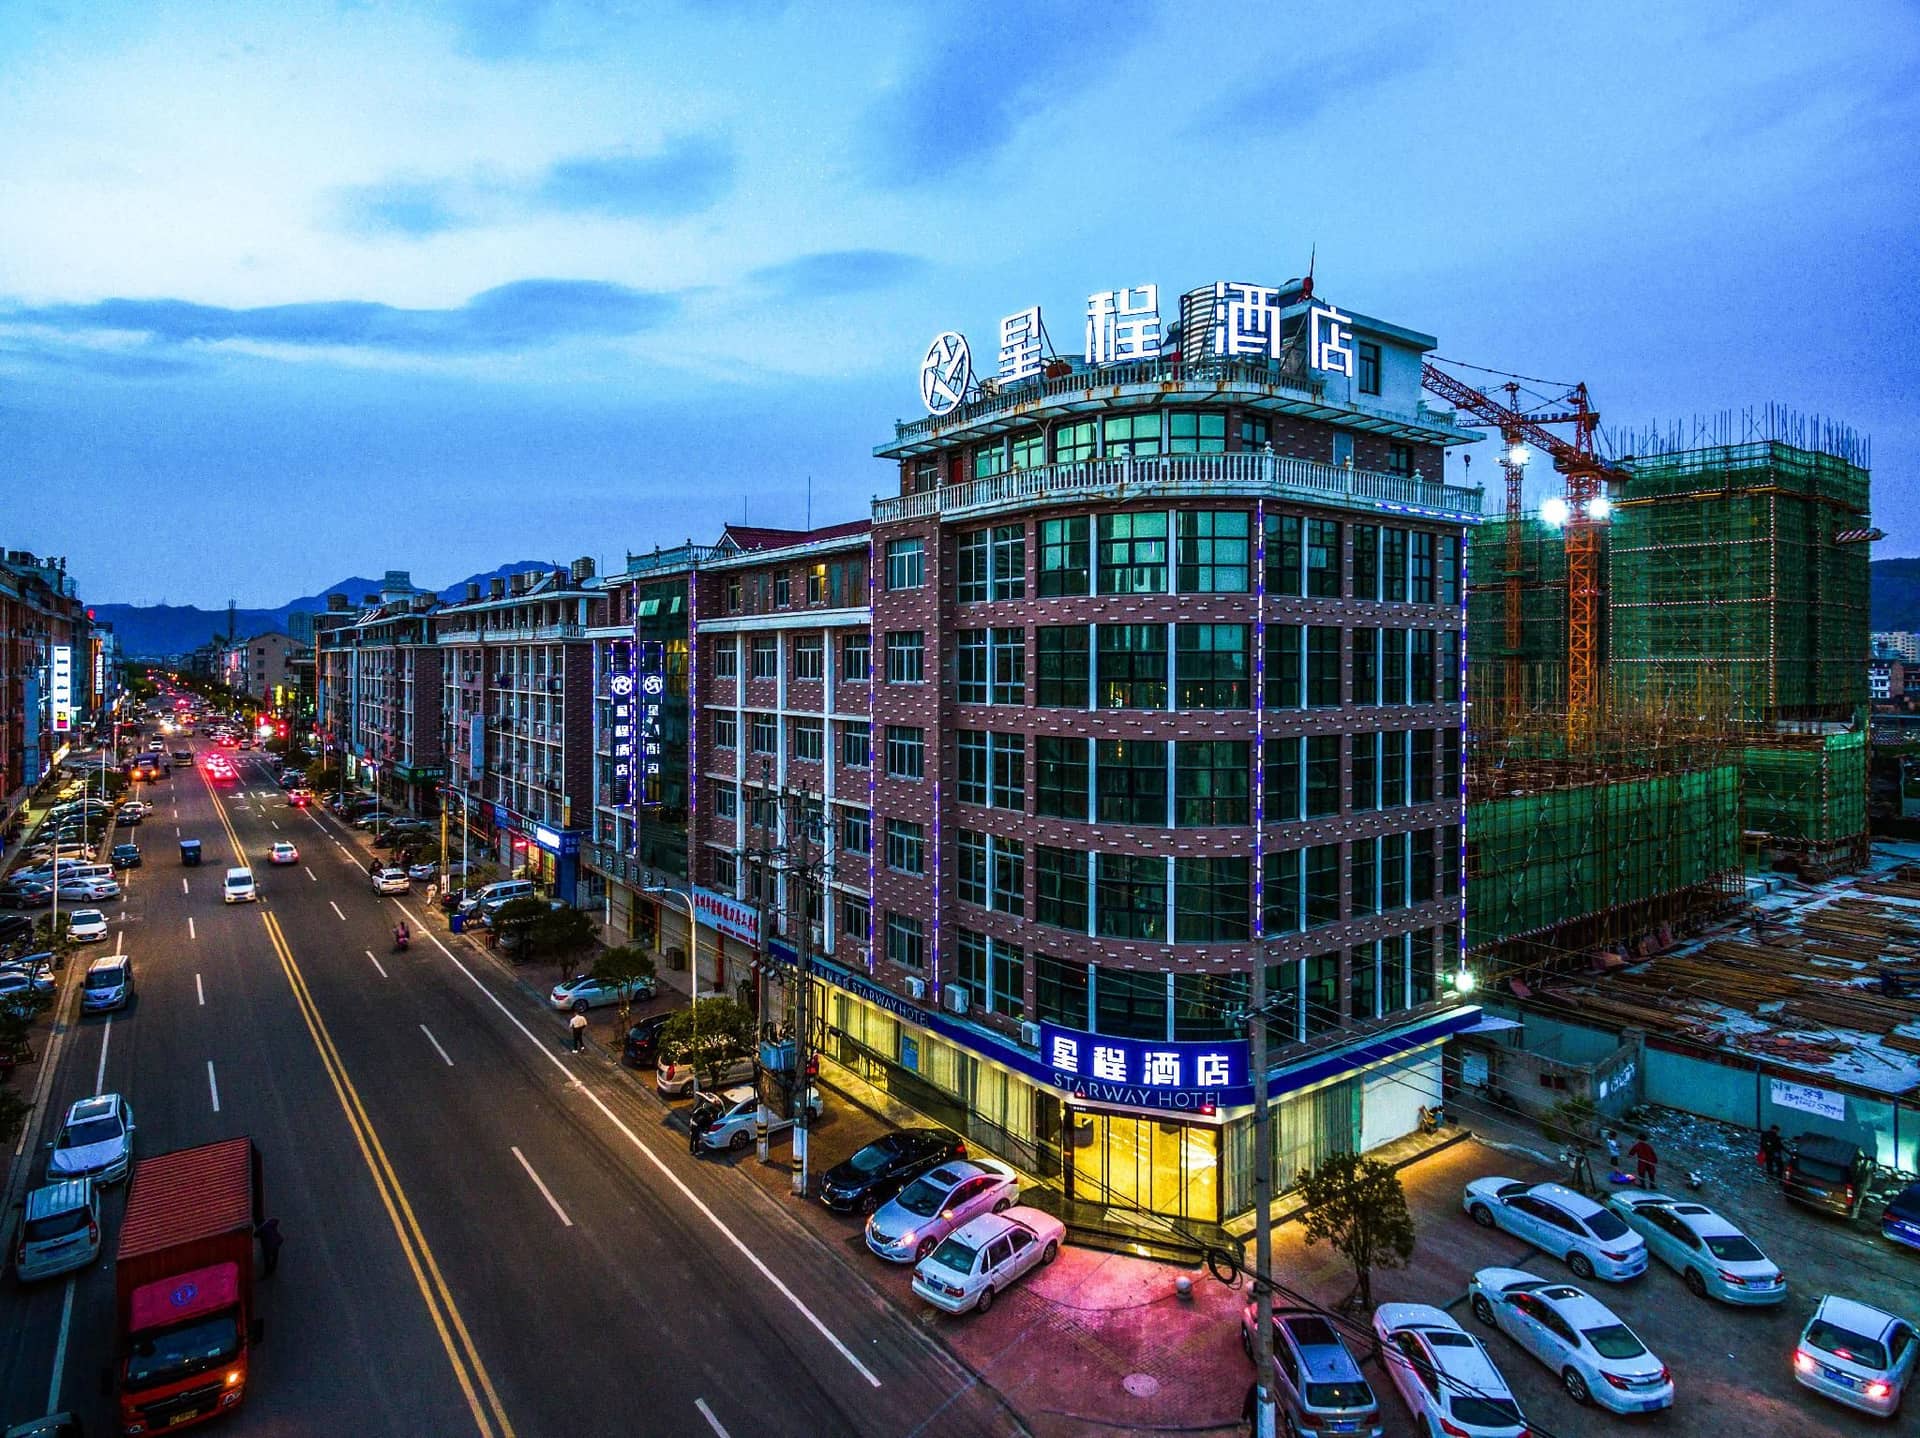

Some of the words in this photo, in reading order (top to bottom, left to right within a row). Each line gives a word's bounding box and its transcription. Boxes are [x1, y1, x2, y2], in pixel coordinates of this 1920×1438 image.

[997, 280, 1354, 385] 星程酒店
[615, 704, 630, 776] 星程酒店
[852, 982, 897, 1012] STARWAY
[1052, 1036, 1229, 1087] 星程酒店
[1054, 1072, 1151, 1105] STARWAY
[1158, 1090, 1226, 1107] HOTEL
